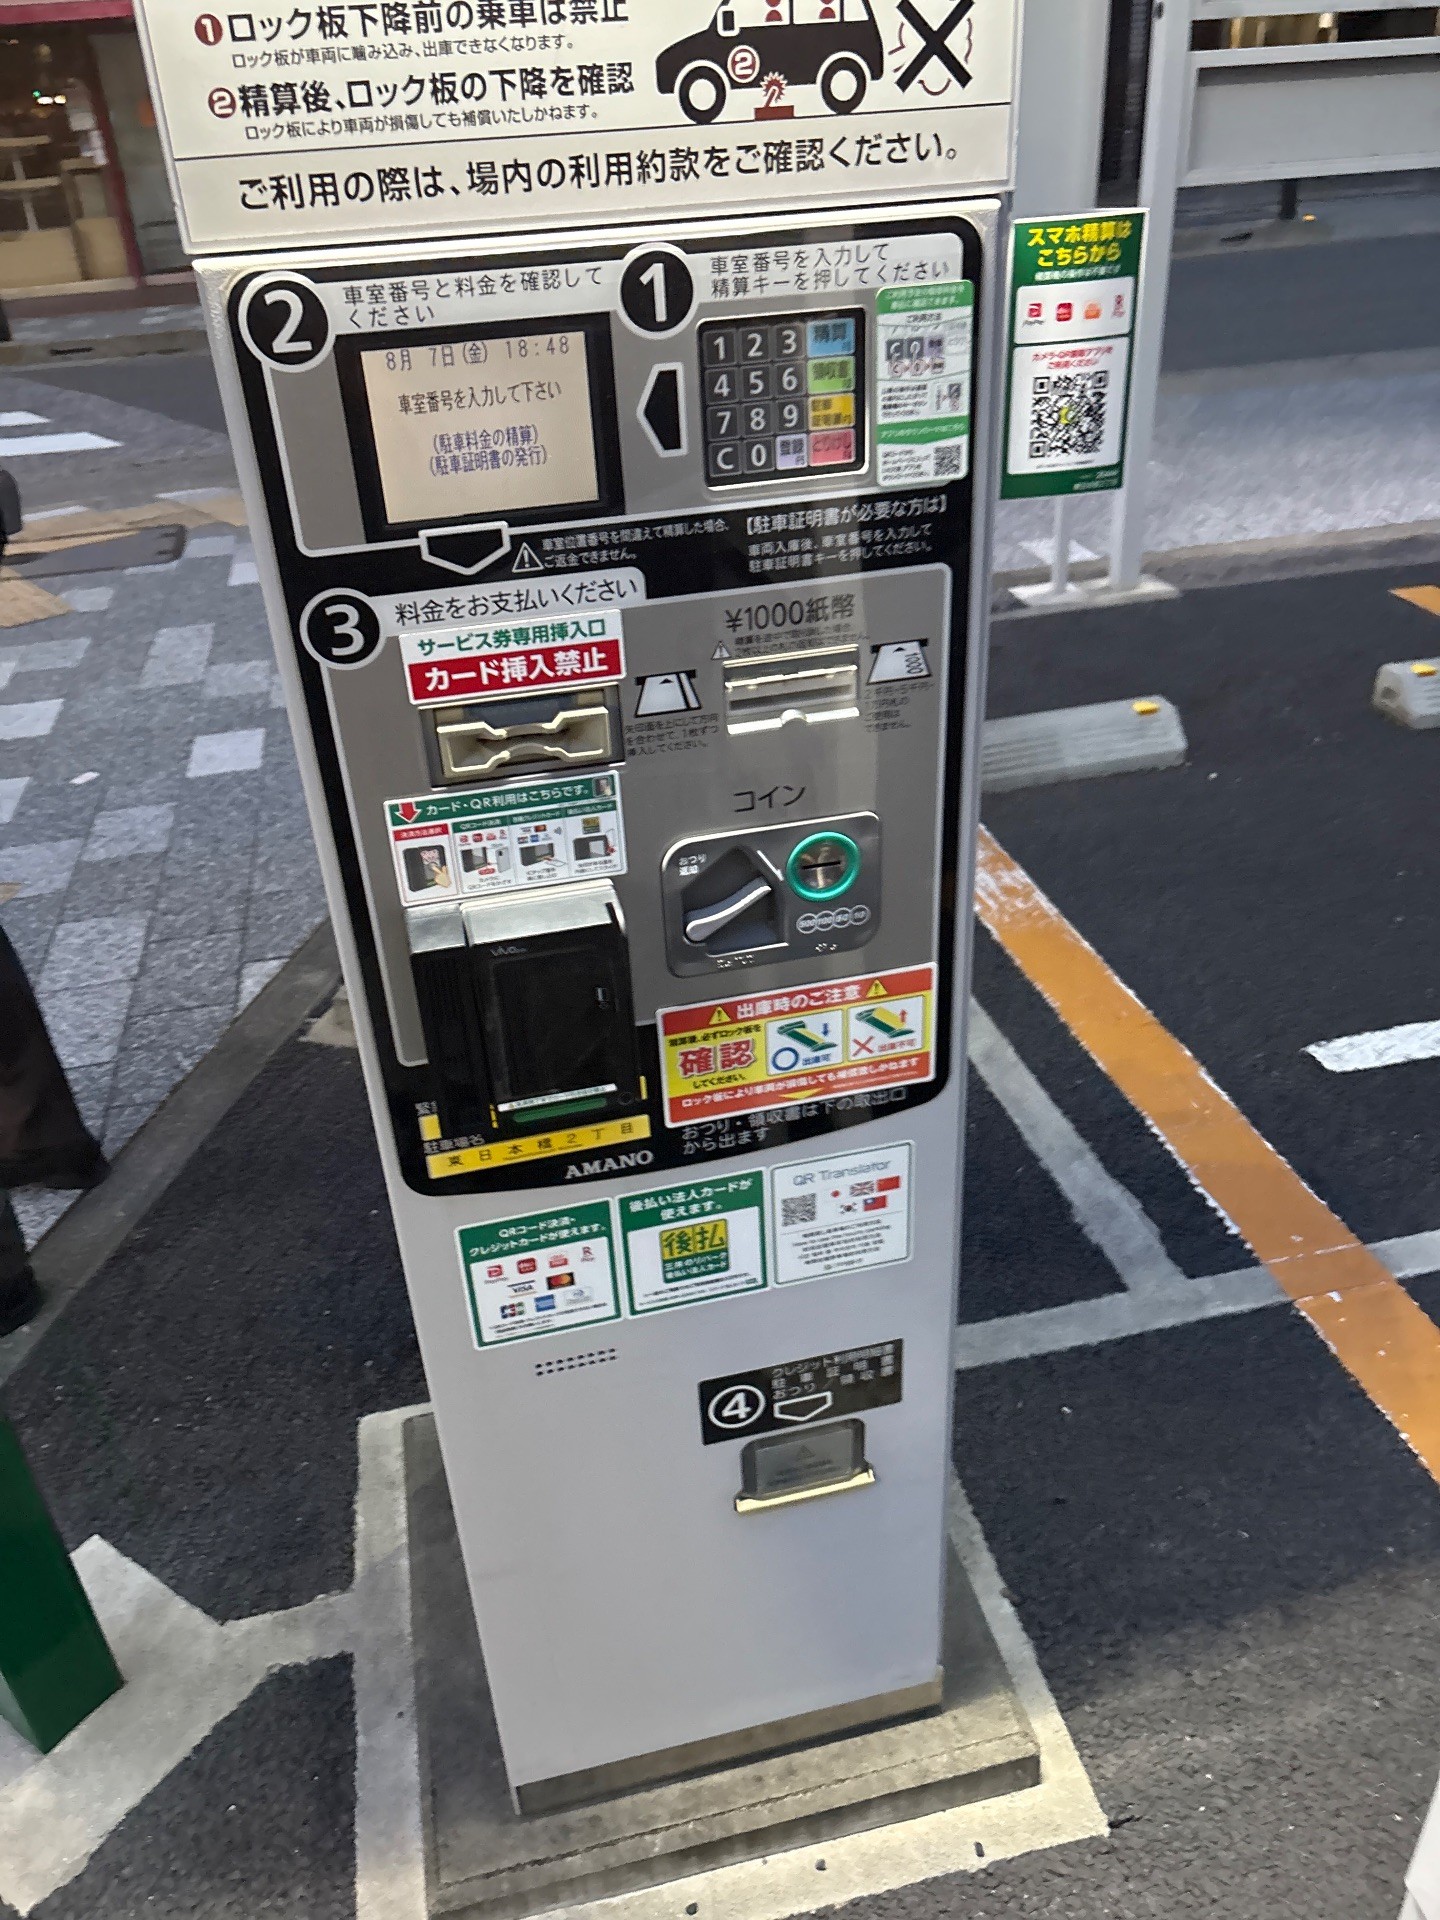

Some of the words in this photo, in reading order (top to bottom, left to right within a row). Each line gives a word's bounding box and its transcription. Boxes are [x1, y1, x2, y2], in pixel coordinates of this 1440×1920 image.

[229, 0, 629, 42] ロック板下降前の乗車は禁止
[233, 37, 574, 69] ロック板が車両に噛み込み、出庫できなくなります。
[238, 63, 634, 118] 精算後、ロック板の下降を確認
[238, 133, 957, 209] ご利用の際は、場内の利用約款をご確認ください。
[711, 243, 889, 275] 車室番号を入力して
[1037, 242, 1121, 267] こちらから
[343, 266, 602, 306] 車室番号と料金を確認して
[639, 263, 667, 323] 1
[711, 261, 950, 298] 精算キーを押してください
[264, 290, 313, 354] 2
[348, 303, 435, 329] ください
[385, 350, 413, 371] 8月
[505, 336, 570, 358] 18:48
[714, 336, 726, 361] 1
[747, 333, 763, 357] 2
[782, 330, 797, 354] 3
[399, 380, 562, 415] 車室番号を入力して下さい
[714, 374, 731, 397] 4
[750, 371, 764, 395] 5
[782, 368, 798, 391] 6
[717, 411, 731, 434] 7
[750, 408, 766, 431] 8
[783, 405, 798, 428] 9
[433, 424, 538, 454] (駐車料金の精算)
[717, 448, 734, 469] C
[751, 444, 767, 466] 0
[746, 494, 947, 535] 【駐車証明書が必要な方は】
[394, 579, 637, 626] 料金をお支払いください
[324, 603, 365, 656] 3
[418, 619, 605, 656] サービス券専用挿入口
[425, 648, 609, 692] カード挿入禁止
[426, 785, 589, 816] カード・QR利用はこちらです。
[734, 785, 806, 812] コイン
[736, 985, 861, 1019] 出庫時のご注意
[679, 1038, 755, 1078] 確認
[683, 1127, 770, 1155] から出ます
[565, 1150, 654, 1180] AMANO
[793, 1173, 815, 1187] QR
[819, 1160, 891, 1181] Translator
[663, 1223, 726, 1255] 後払
[721, 1393, 752, 1419] 4
